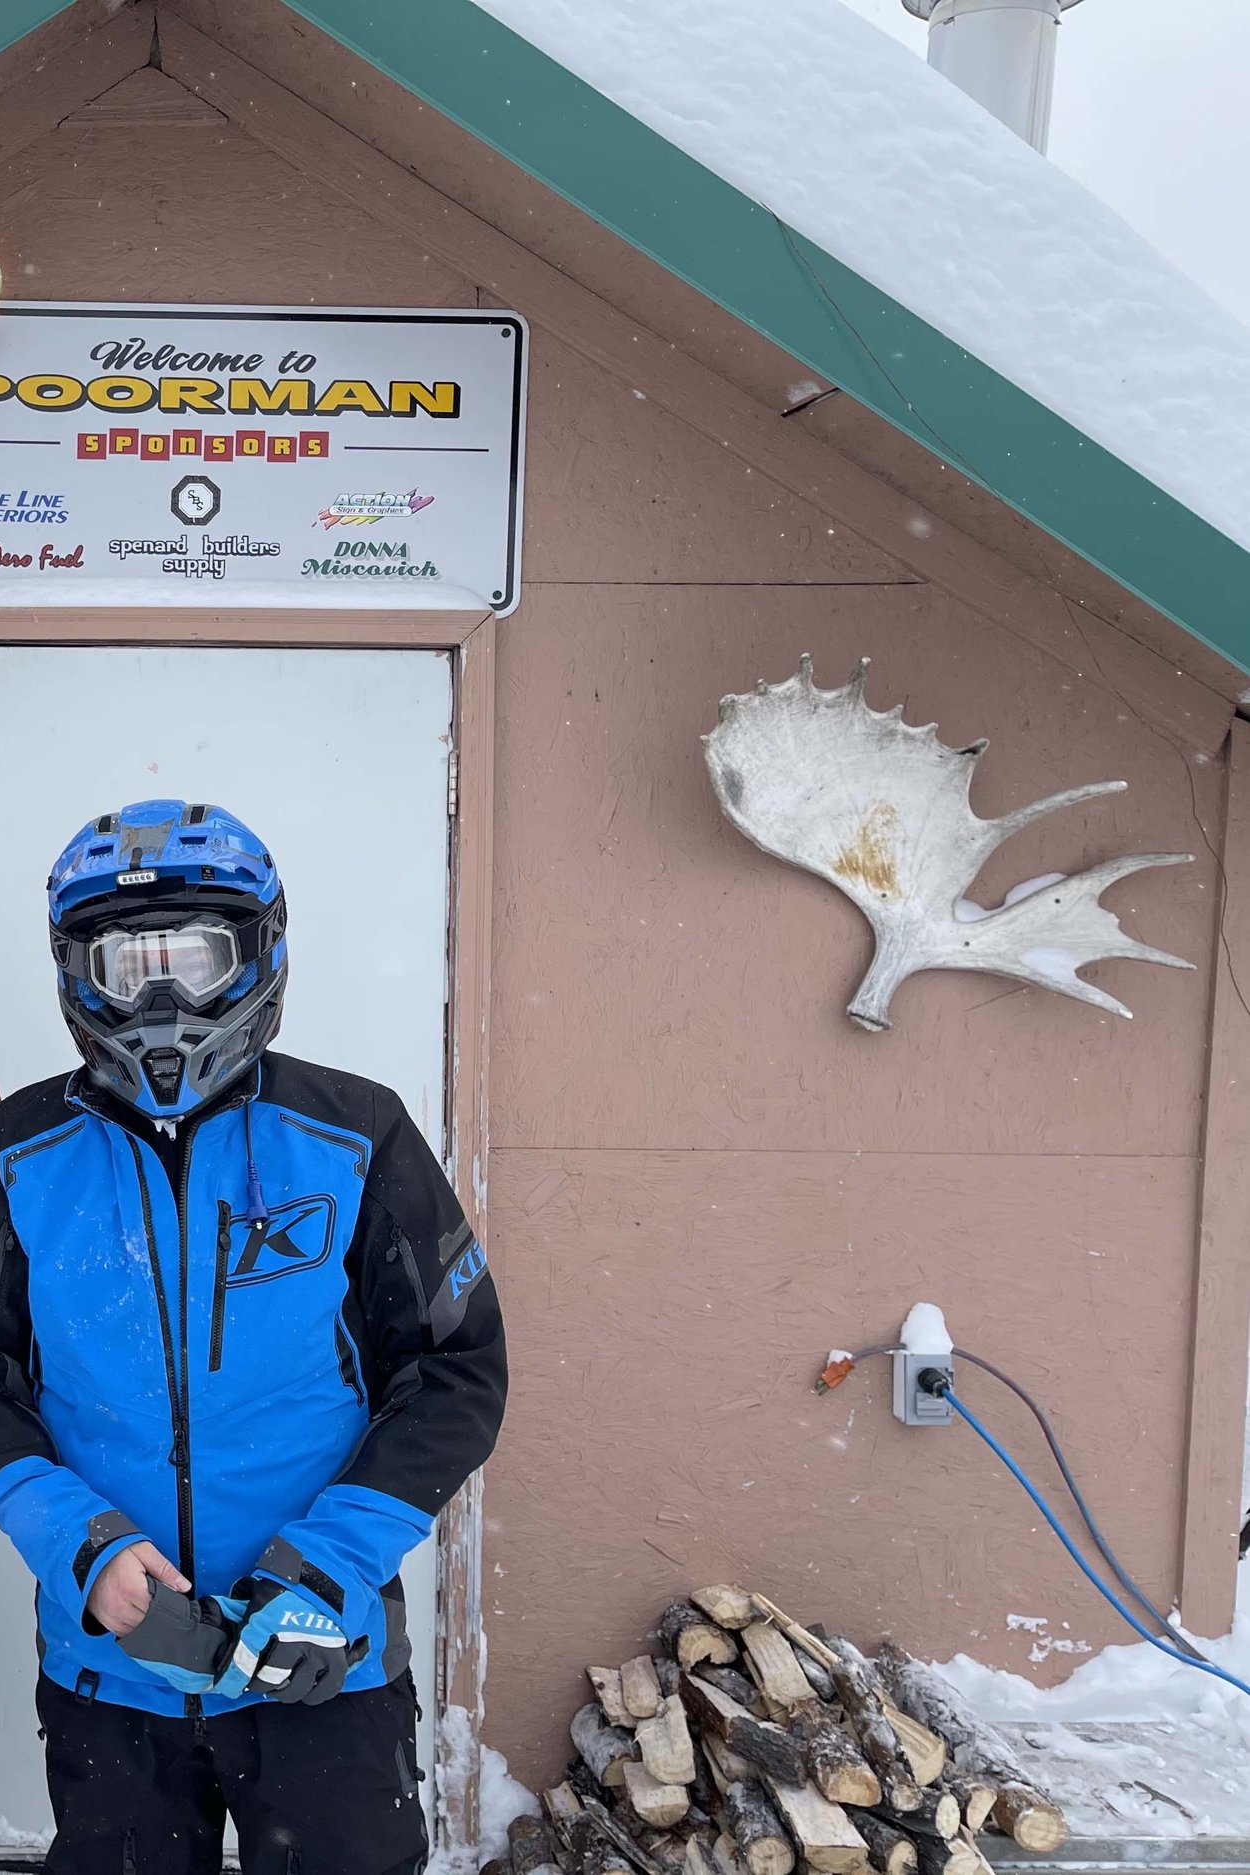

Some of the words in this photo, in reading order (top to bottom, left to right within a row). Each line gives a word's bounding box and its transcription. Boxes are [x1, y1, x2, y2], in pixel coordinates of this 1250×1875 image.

[90, 337, 264, 373] Welcome
[278, 350, 317, 374] to
[84, 433, 323, 458] SPONSORS
[17, 490, 65, 508] LINE
[332, 493, 411, 506] ACTION
[39, 544, 84, 570] Fuel
[109, 535, 188, 560] spenard
[202, 534, 281, 556] builders
[333, 541, 409, 559] DONNA
[162, 555, 226, 579] supply
[301, 558, 439, 578] Miscovich
